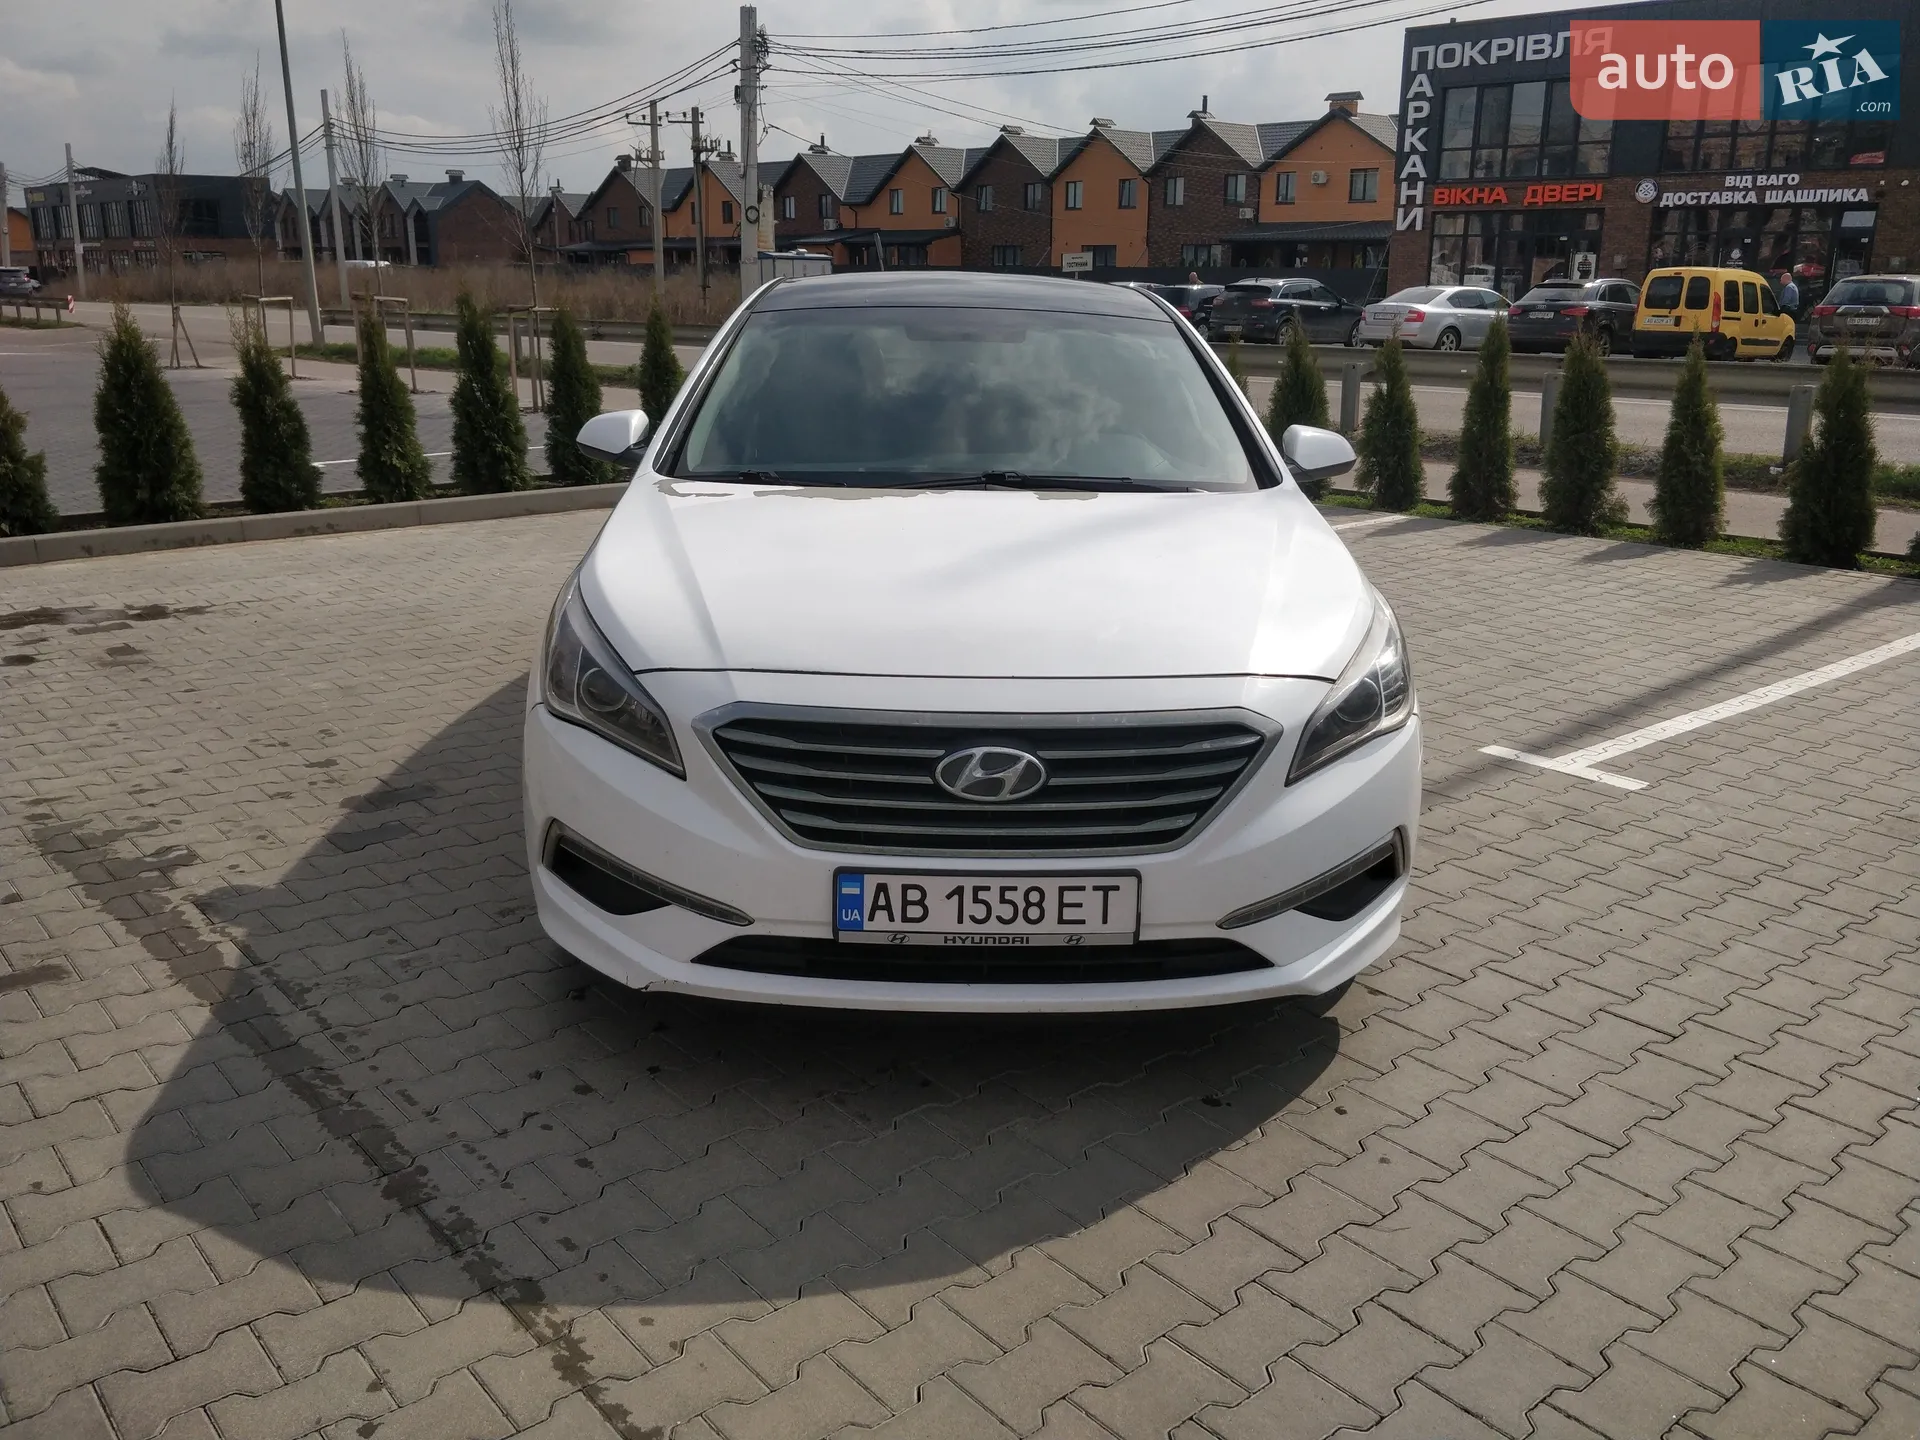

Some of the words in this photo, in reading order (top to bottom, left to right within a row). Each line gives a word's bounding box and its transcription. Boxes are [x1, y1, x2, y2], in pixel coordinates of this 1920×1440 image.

[1411, 27, 1613, 71] ПОКРІВЛЯ
[1725, 175, 1752, 188] ВІД
[1756, 173, 1800, 186] ВАГО
[1433, 187, 1507, 205] ВІКНА
[1523, 183, 1603, 207] ДВЕРІ
[1660, 191, 1757, 207] ДОСТАВКА
[1764, 188, 1869, 203] ШАШЛИКА
[867, 882, 929, 923] AB
[945, 885, 1045, 924] 1558
[1057, 885, 1120, 924] ET
[842, 909, 861, 921] UA
[944, 935, 1030, 945] HYUNDAI
